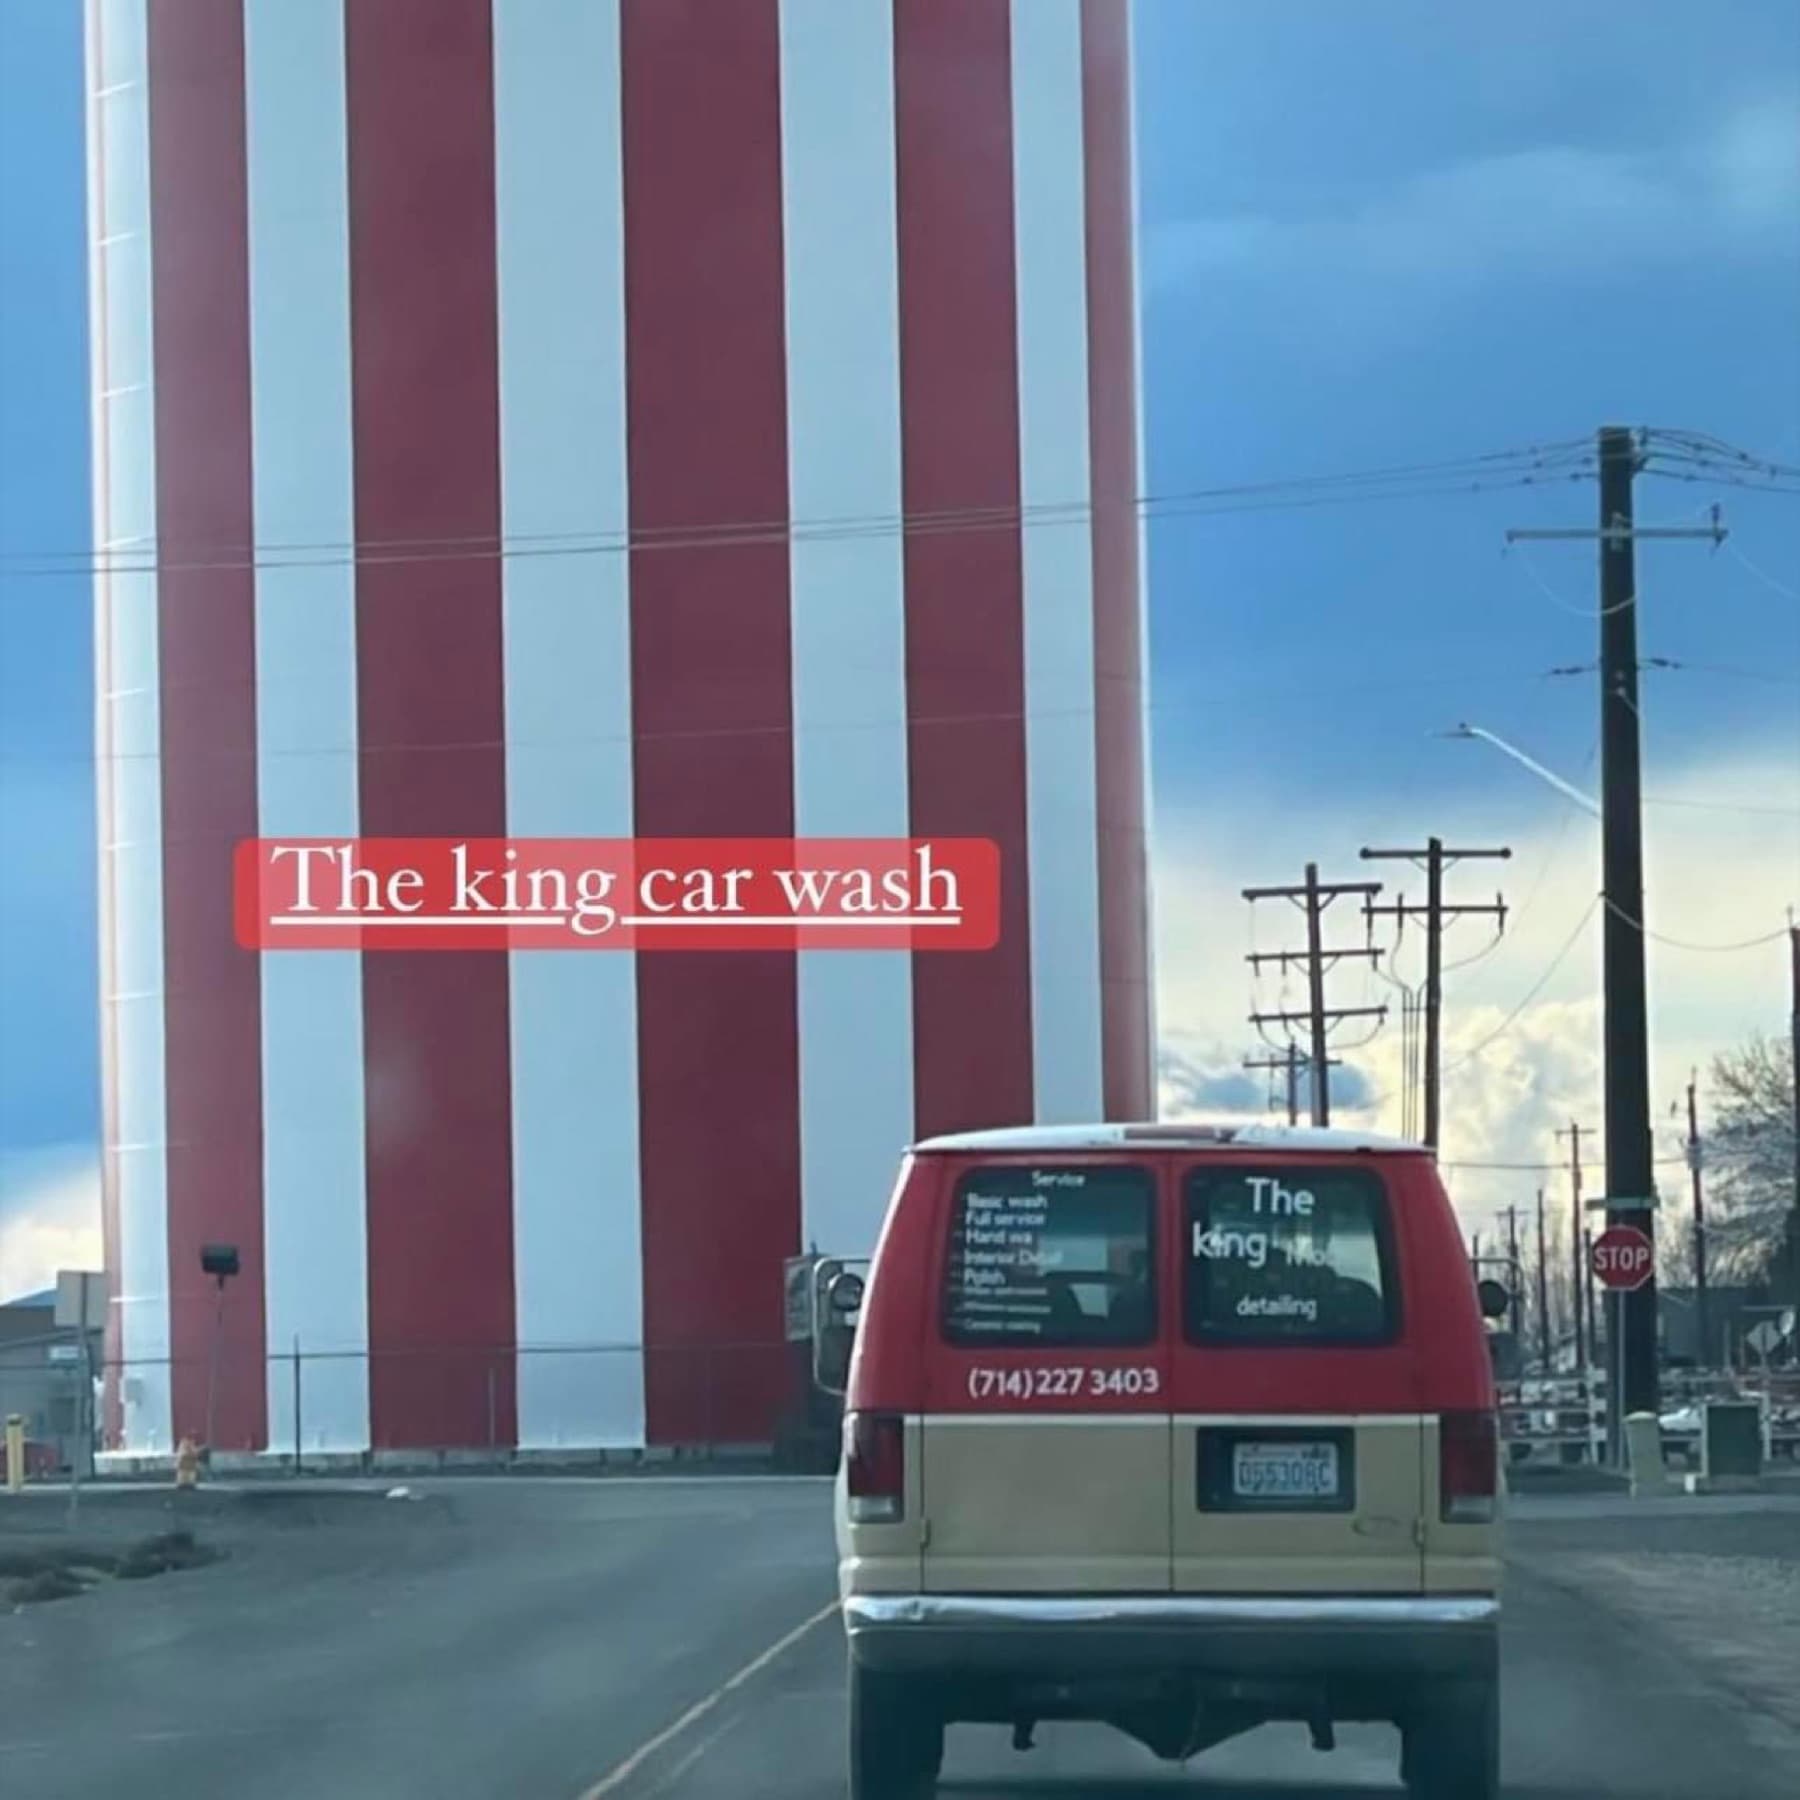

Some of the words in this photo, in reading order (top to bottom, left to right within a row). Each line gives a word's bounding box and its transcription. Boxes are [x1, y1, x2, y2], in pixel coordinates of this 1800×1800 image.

[1032, 1170, 1086, 1187] Service
[1008, 1194, 1048, 1209] wash
[1245, 1176, 1316, 1214] The
[965, 1210, 991, 1225] Full
[994, 1212, 1045, 1225] service
[965, 1228, 1006, 1244] Hand
[1192, 1220, 1268, 1269] king
[1594, 1246, 1649, 1271] STOP
[1236, 1293, 1317, 1322] detailing
[1090, 1367, 1160, 1396] 3403
